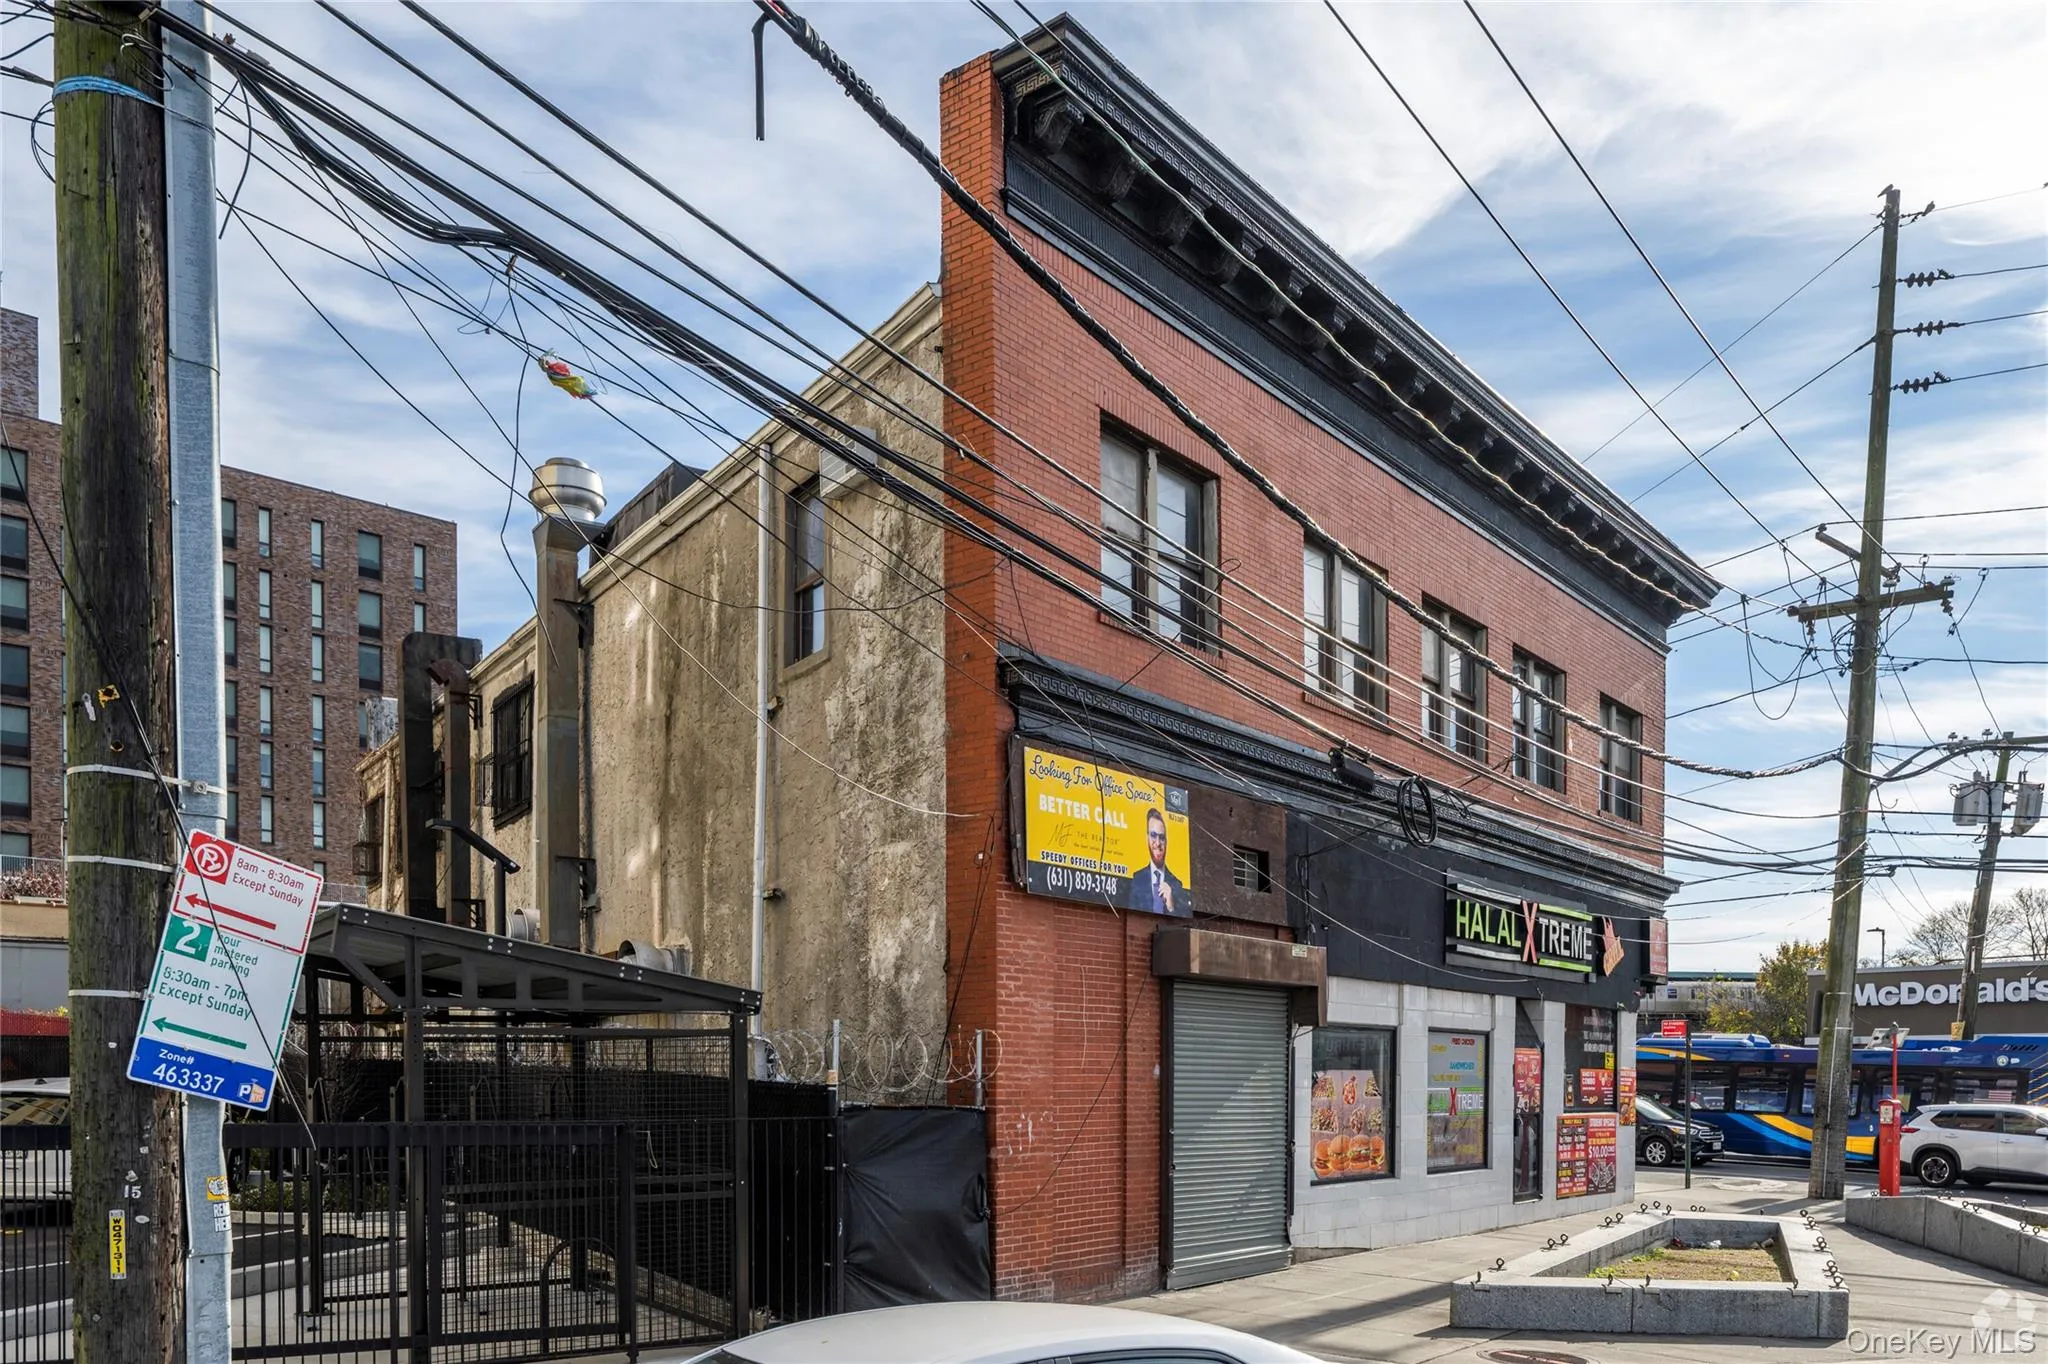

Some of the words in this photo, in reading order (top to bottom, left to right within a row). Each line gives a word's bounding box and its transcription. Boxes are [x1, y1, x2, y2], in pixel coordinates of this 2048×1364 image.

[1030, 754, 1072, 788] Looking
[1072, 766, 1092, 786] For
[1094, 772, 1124, 797] Office
[1126, 781, 1157, 802] Space?
[1039, 793, 1090, 822] BETTER
[1094, 806, 1128, 830] CALL
[236, 858, 258, 874] 8am
[267, 868, 305, 891] 8:30am
[1041, 850, 1067, 865] SPEEDY
[1070, 856, 1096, 870] OFFICES
[1100, 862, 1112, 873] FOR
[1114, 864, 1128, 875] YOU!
[232, 873, 266, 896] Except
[270, 882, 304, 908] Sunday
[1046, 866, 1073, 894] (631)
[1075, 872, 1118, 896] 839-3748
[175, 920, 202, 954] 2
[1456, 899, 1522, 948] HALAL
[1522, 900, 1593, 964] XTREME
[210, 957, 250, 978] parking
[214, 946, 258, 966] metered
[162, 966, 211, 992] 8:30am
[224, 984, 249, 1002] 7pm
[159, 982, 204, 1007] Except
[206, 996, 252, 1021] Sunday
[159, 1048, 195, 1066] Zone#
[152, 1066, 225, 1095] 463337
[124, 1185, 142, 1199] 15
